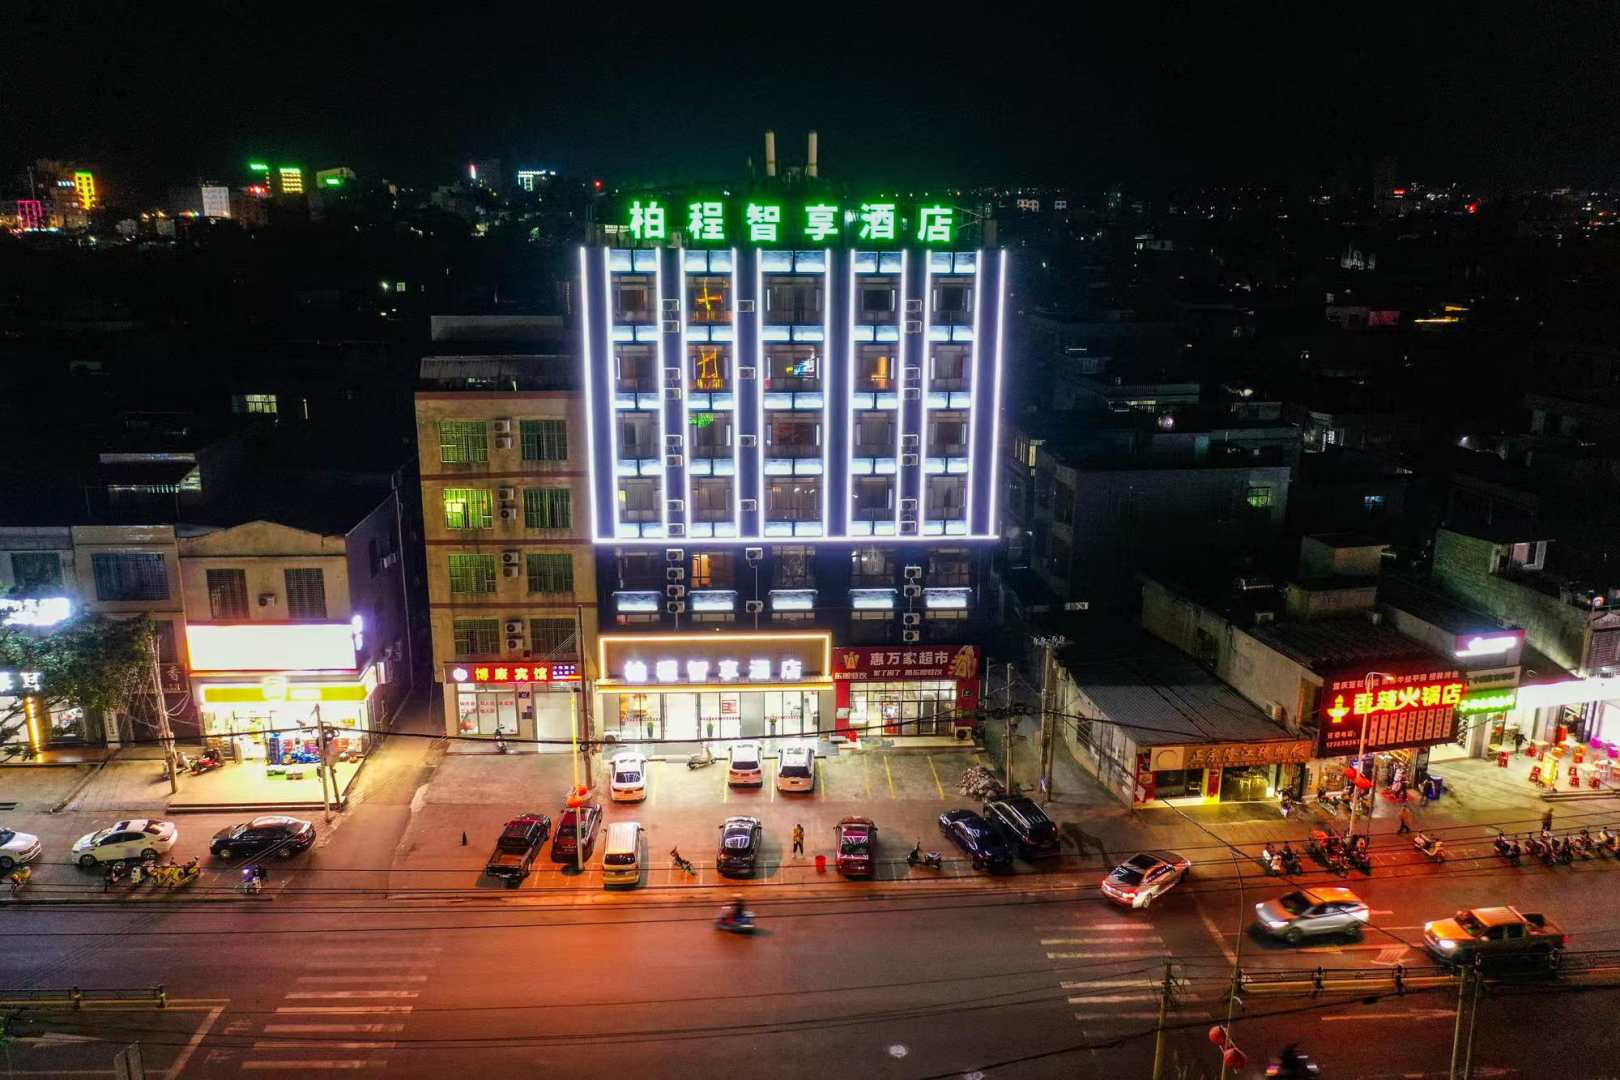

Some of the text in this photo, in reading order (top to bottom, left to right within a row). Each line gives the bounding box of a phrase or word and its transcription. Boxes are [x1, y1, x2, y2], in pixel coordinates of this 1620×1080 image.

[629, 200, 954, 242] 柏程智享酒店
[869, 651, 950, 666] 惠万家超市
